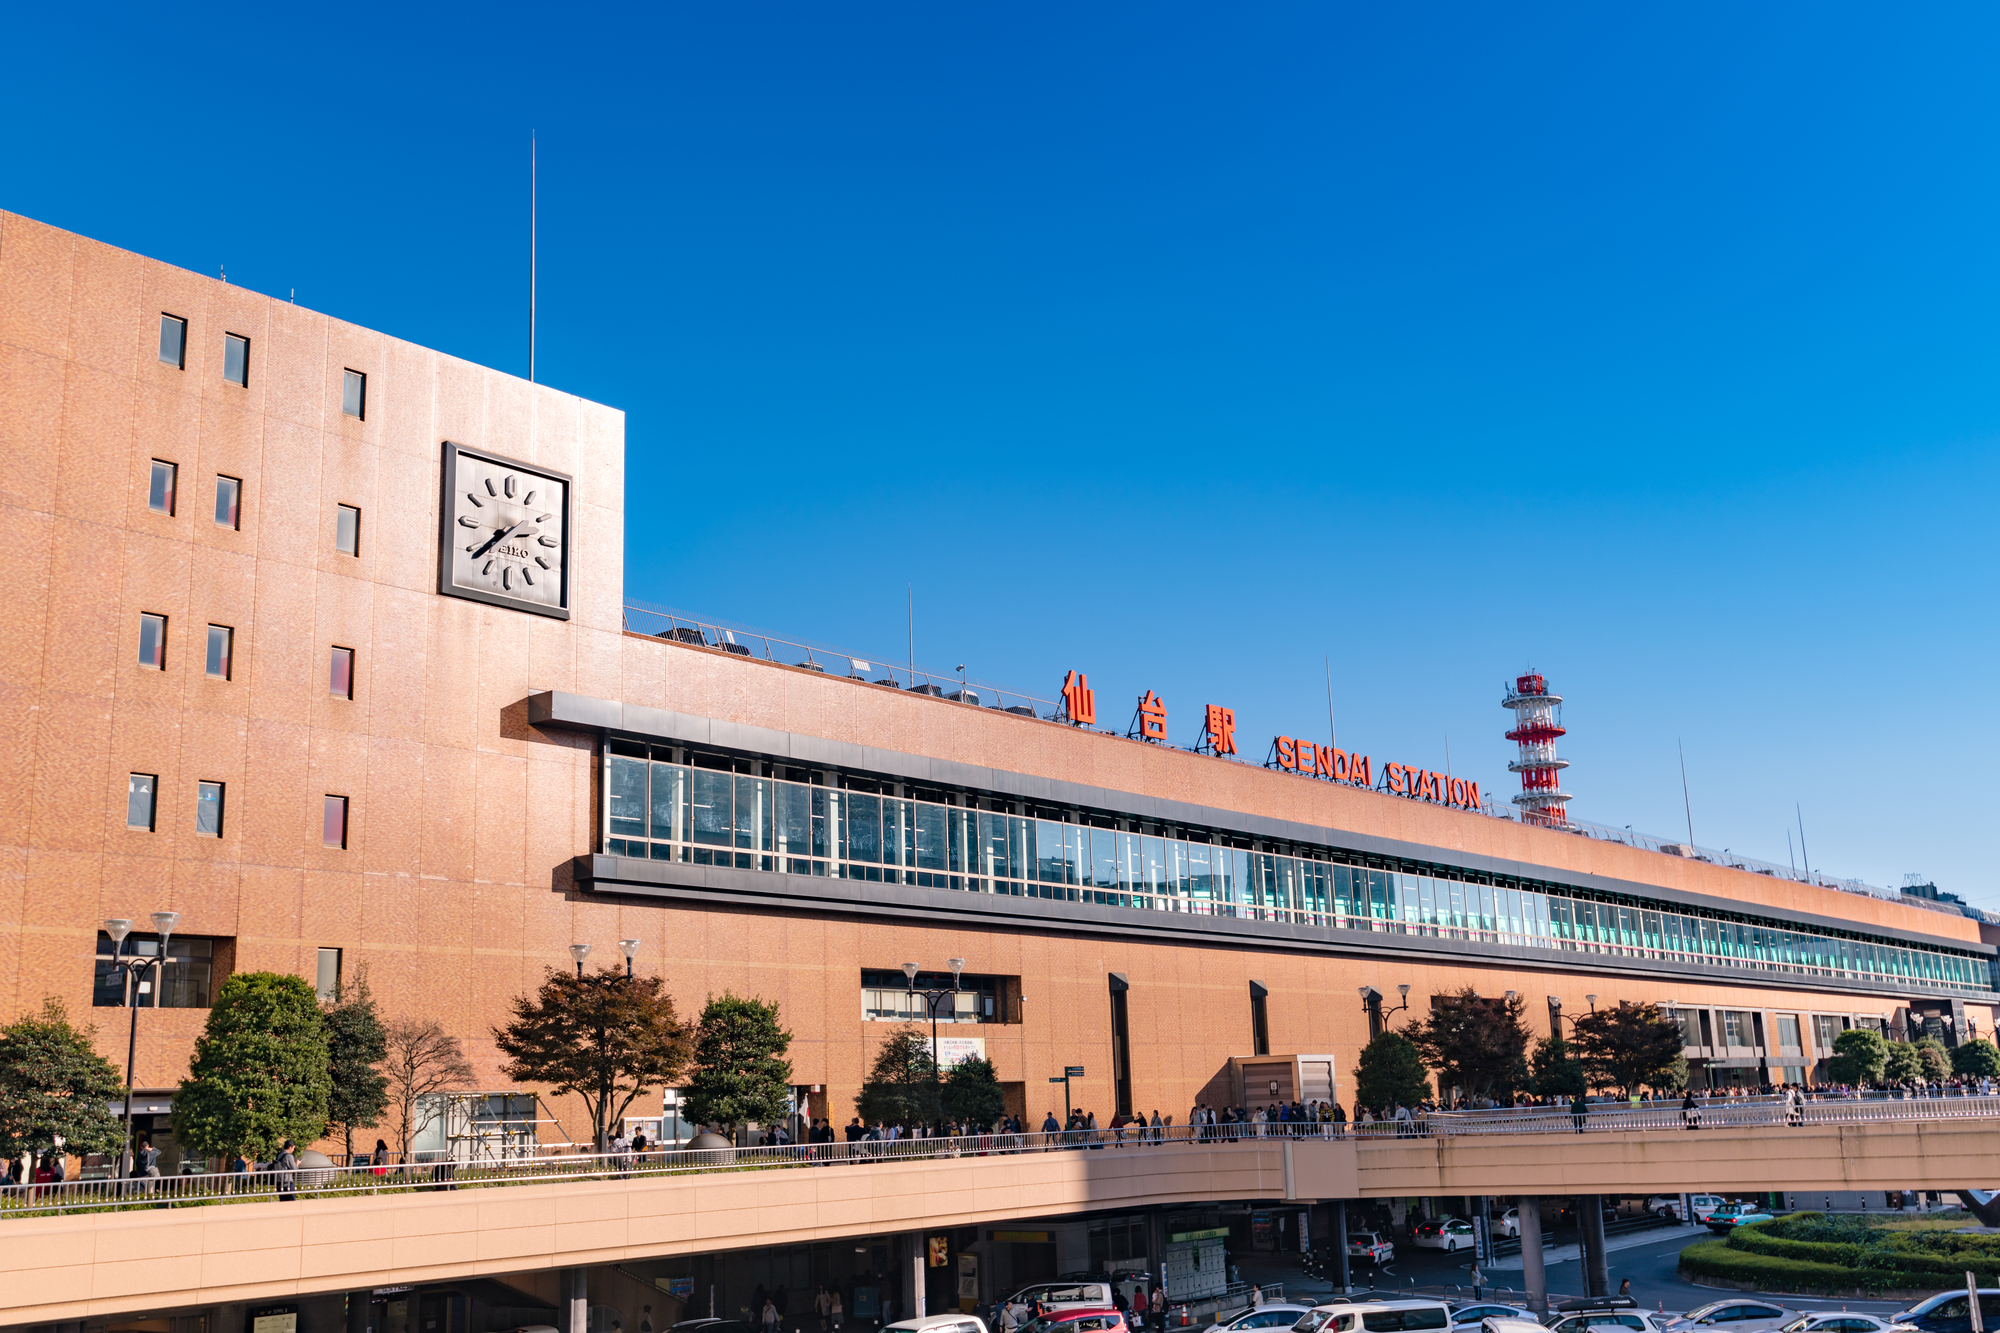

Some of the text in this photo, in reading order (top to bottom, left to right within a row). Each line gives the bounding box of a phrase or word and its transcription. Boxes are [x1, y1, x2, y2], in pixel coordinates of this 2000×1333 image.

[491, 544, 529, 558] EIKO
[1061, 669, 1238, 755] 仙台駅
[1277, 735, 1481, 809] SENDAI STATION
[1201, 1230, 1217, 1238] LOCKER
